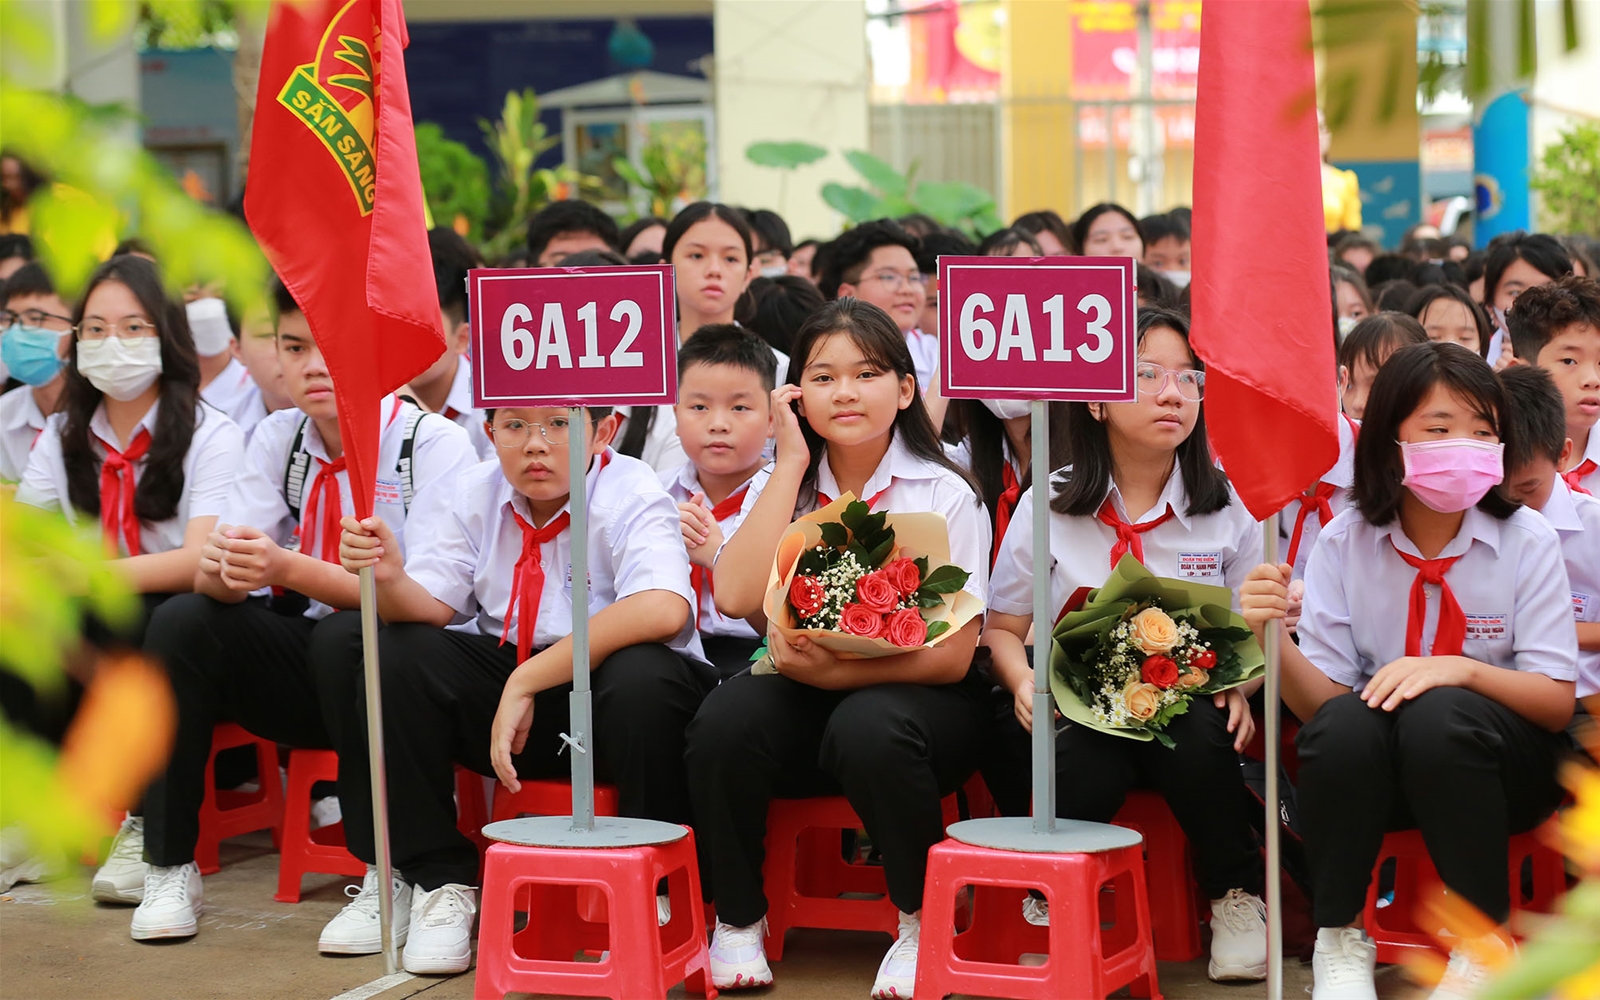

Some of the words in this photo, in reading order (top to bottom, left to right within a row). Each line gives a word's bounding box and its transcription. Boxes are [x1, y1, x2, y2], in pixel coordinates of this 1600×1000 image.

[292, 90, 342, 137] SẴN
[500, 299, 644, 371] 6A12
[959, 292, 1114, 364] 6A13
